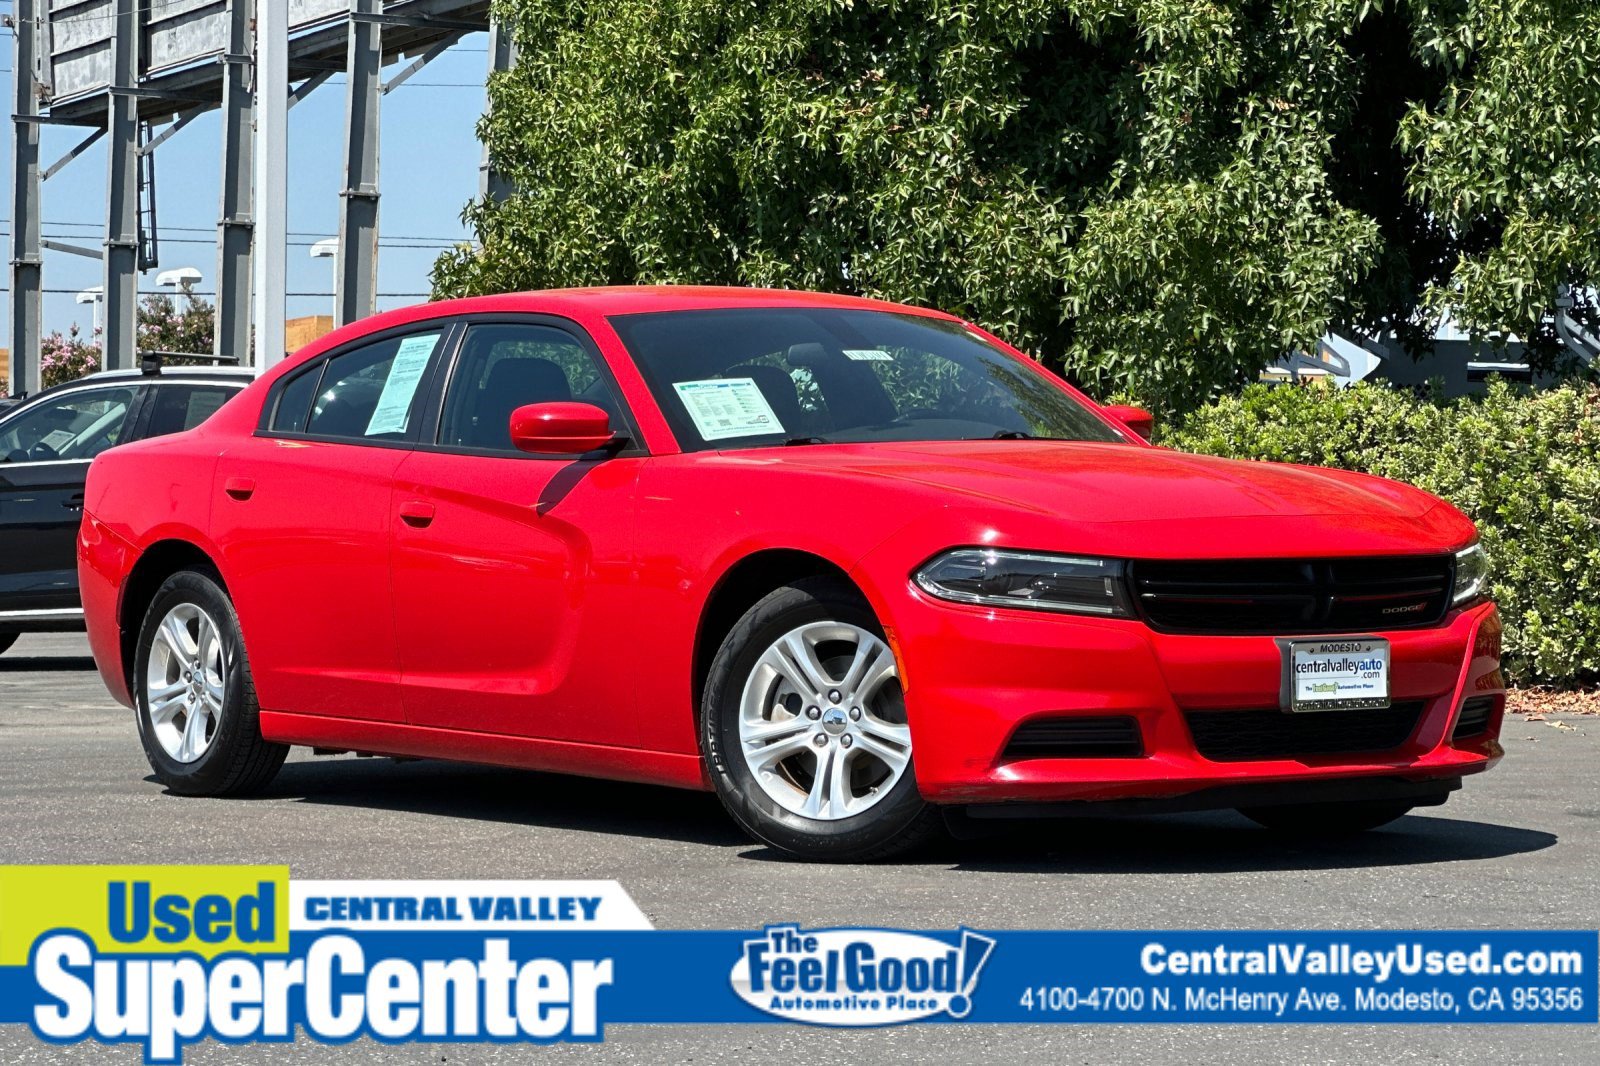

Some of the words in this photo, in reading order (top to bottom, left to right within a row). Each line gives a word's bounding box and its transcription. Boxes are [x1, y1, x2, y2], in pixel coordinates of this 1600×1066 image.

[1382, 604, 1422, 614] DODGE
[1320, 643, 1361, 653] MODESTO
[1296, 658, 1382, 675] centralvalleyauto
[1361, 671, 1380, 679] .com
